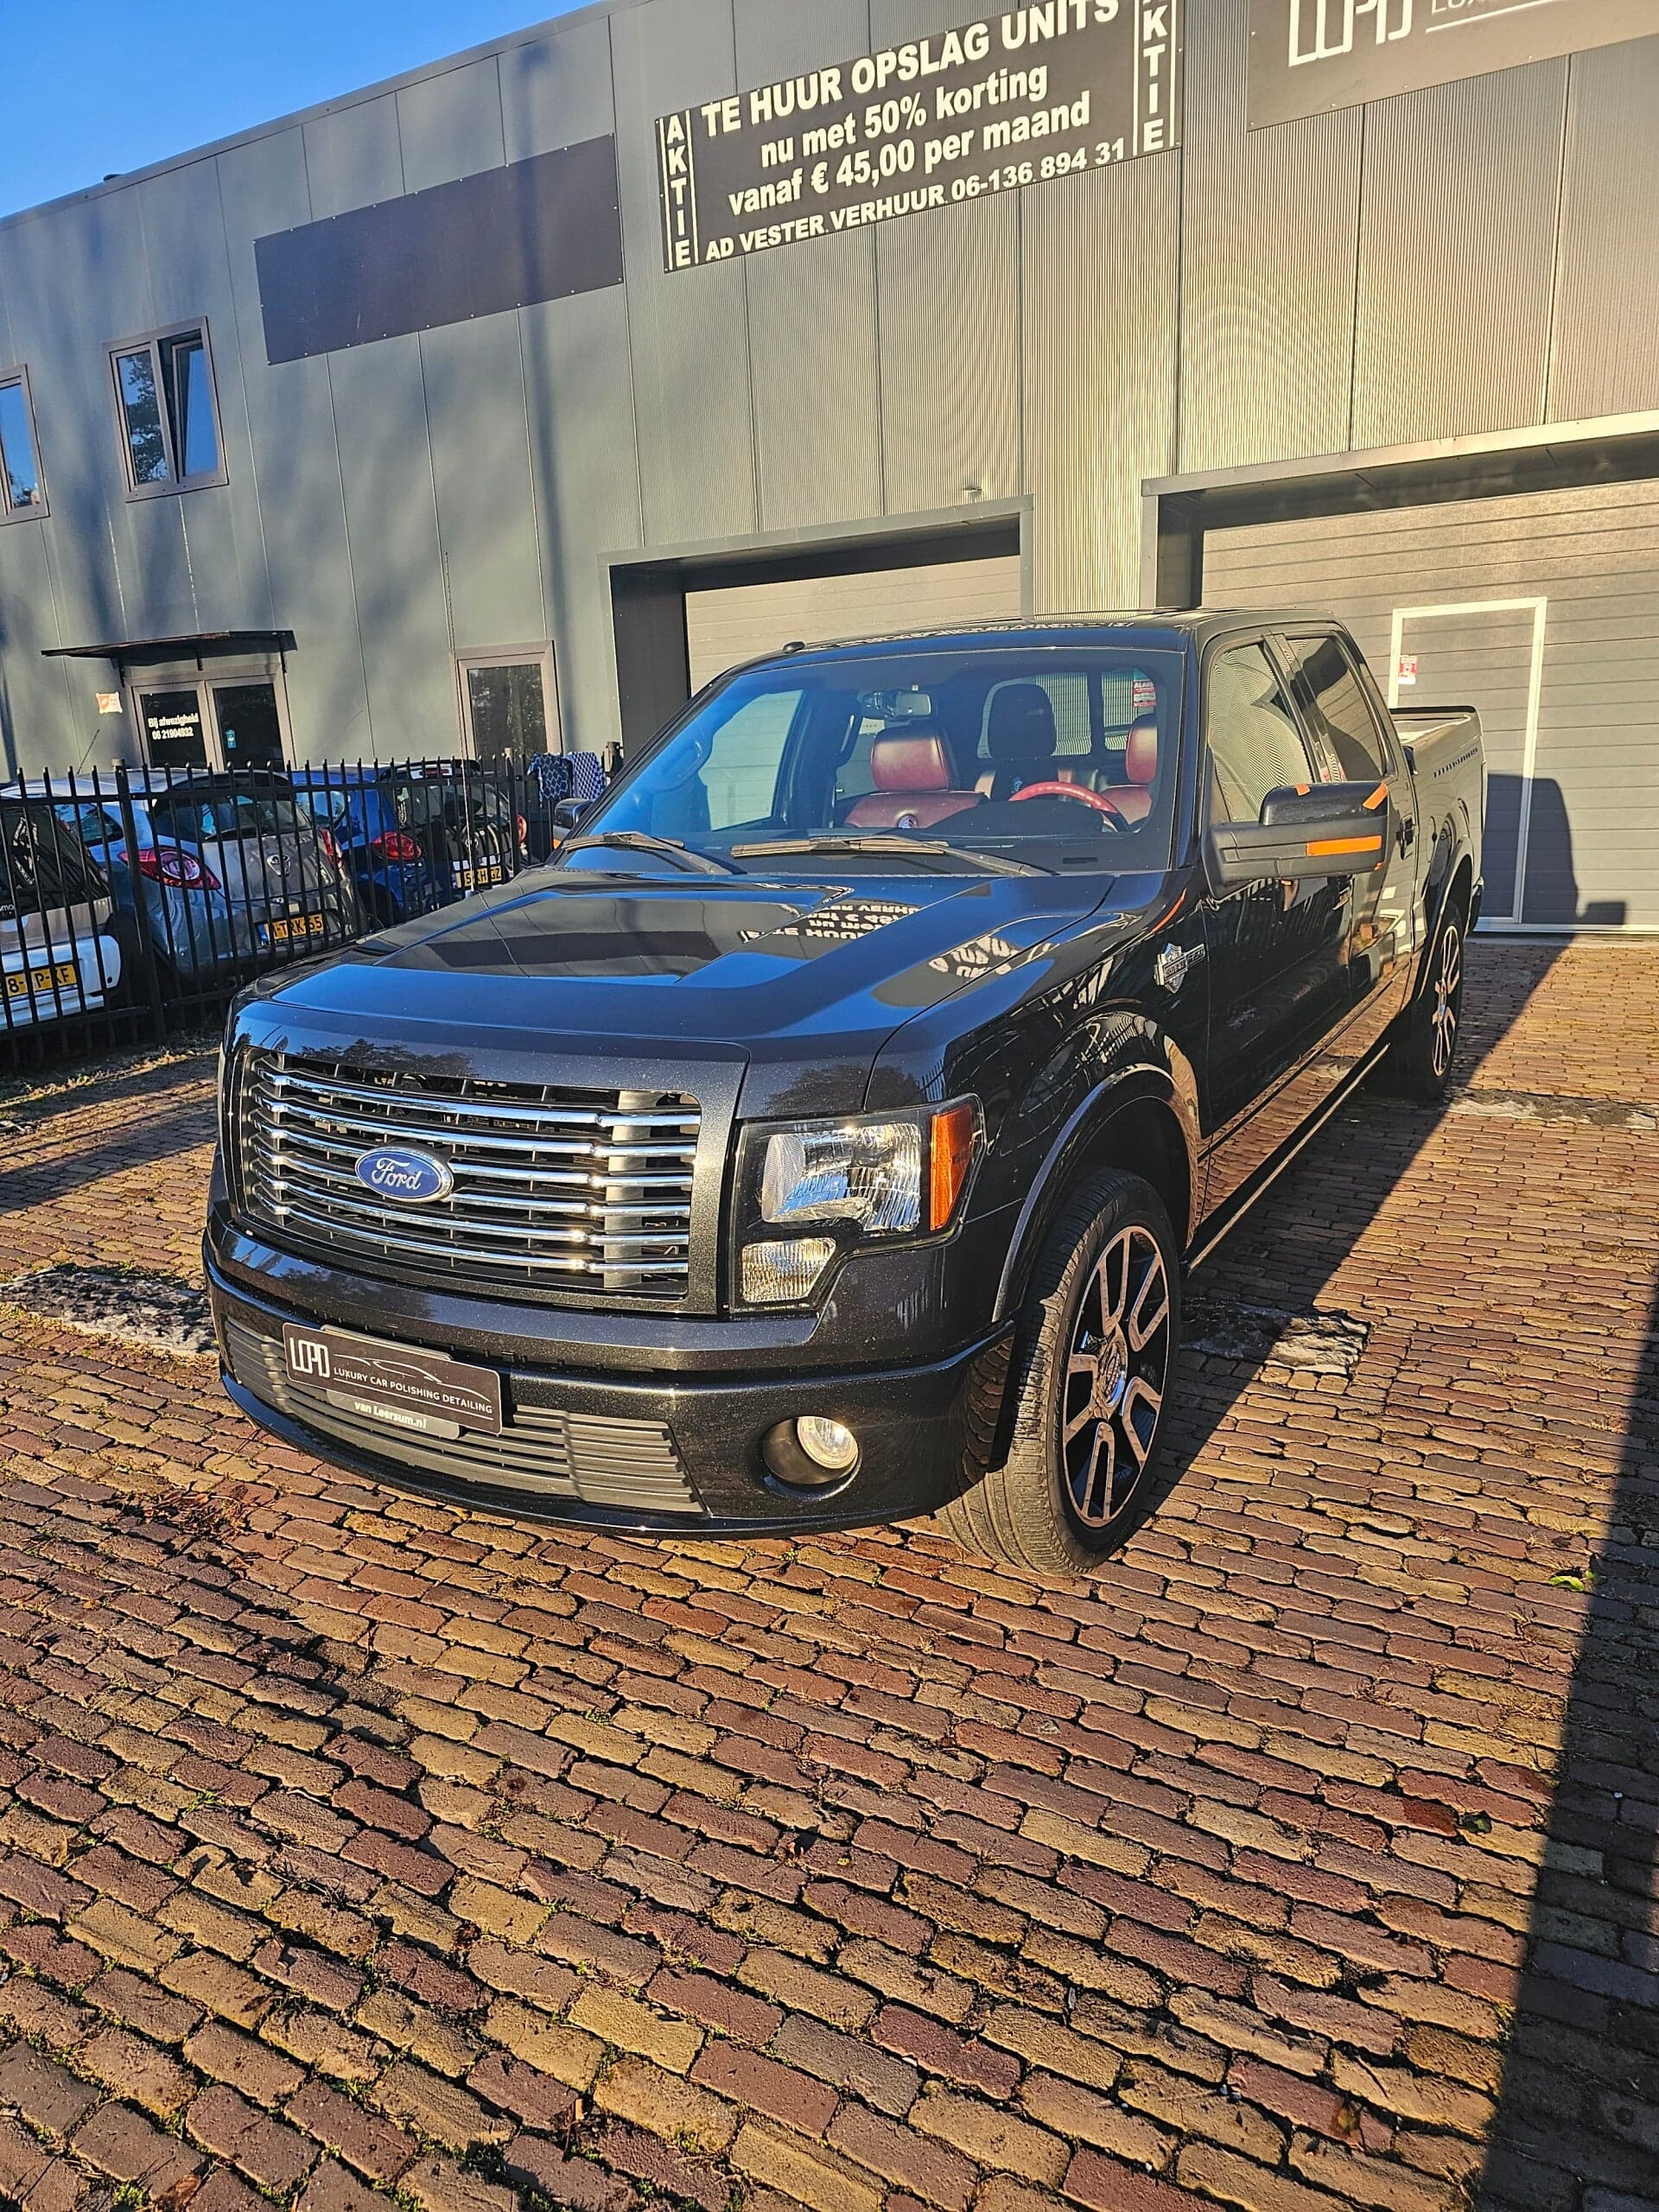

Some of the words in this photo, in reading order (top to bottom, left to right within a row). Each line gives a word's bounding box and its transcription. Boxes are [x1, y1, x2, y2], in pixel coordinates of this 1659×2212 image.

[701, 101, 741, 137] TE
[751, 67, 842, 125] HUUR
[851, 22, 989, 94] OPSLAG
[1001, 0, 1119, 49] UNITS
[761, 137, 794, 168] nu
[802, 112, 856, 157] met
[864, 92, 927, 138] 50%
[936, 66, 1048, 120] korting
[1142, 0, 1168, 152] KTIE
[706, 237, 734, 261] AD
[740, 215, 825, 252] VESTER
[830, 184, 945, 231] VERHUUR
[951, 162, 1033, 200] 06-136
[1040, 147, 1088, 179] 894
[1095, 137, 1124, 165] 31
[728, 168, 804, 215] vanaf
[811, 162, 830, 194] €
[836, 139, 915, 188] 45,00
[925, 130, 975, 175] per
[983, 90, 1090, 150] maand
[372, 1158, 423, 1191] Ford
[334, 1366, 369, 1382] LUXURY
[370, 1376, 388, 1389] CAR
[390, 1380, 441, 1401] POLISHING
[442, 1394, 493, 1414] DETAILING
[354, 1401, 372, 1415] van
[373, 1405, 427, 1430] Leersum.nl
